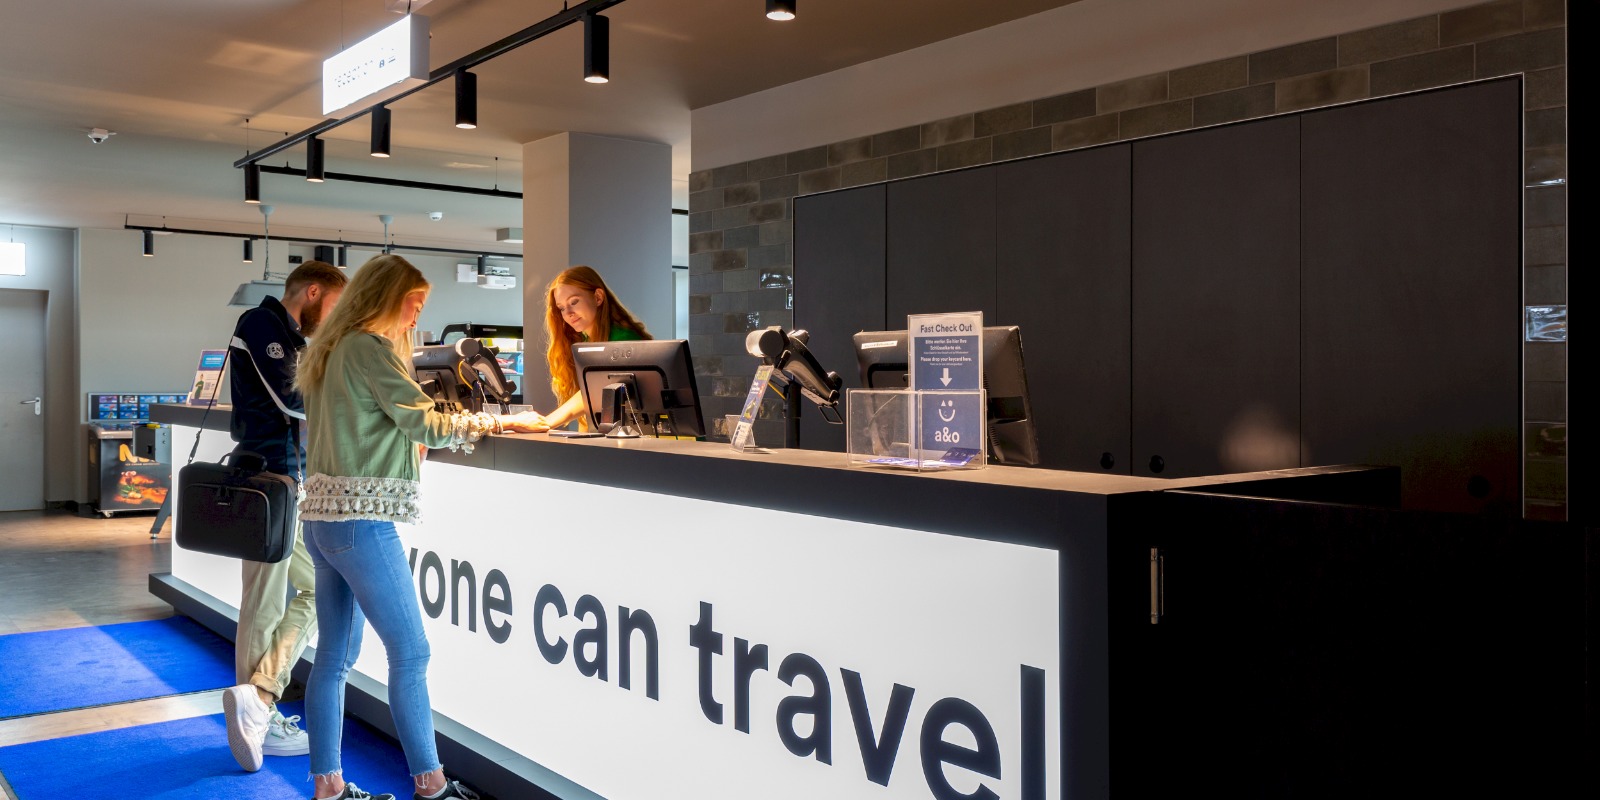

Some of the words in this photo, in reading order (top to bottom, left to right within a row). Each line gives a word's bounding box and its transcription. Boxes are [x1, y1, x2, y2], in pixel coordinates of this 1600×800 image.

[920, 324, 934, 333] Fast
[935, 323, 957, 332] Check
[959, 323, 972, 332] Out
[934, 426, 960, 443] a&o
[409, 547, 513, 644] one
[533, 583, 659, 702] can
[689, 601, 1046, 800] travel
